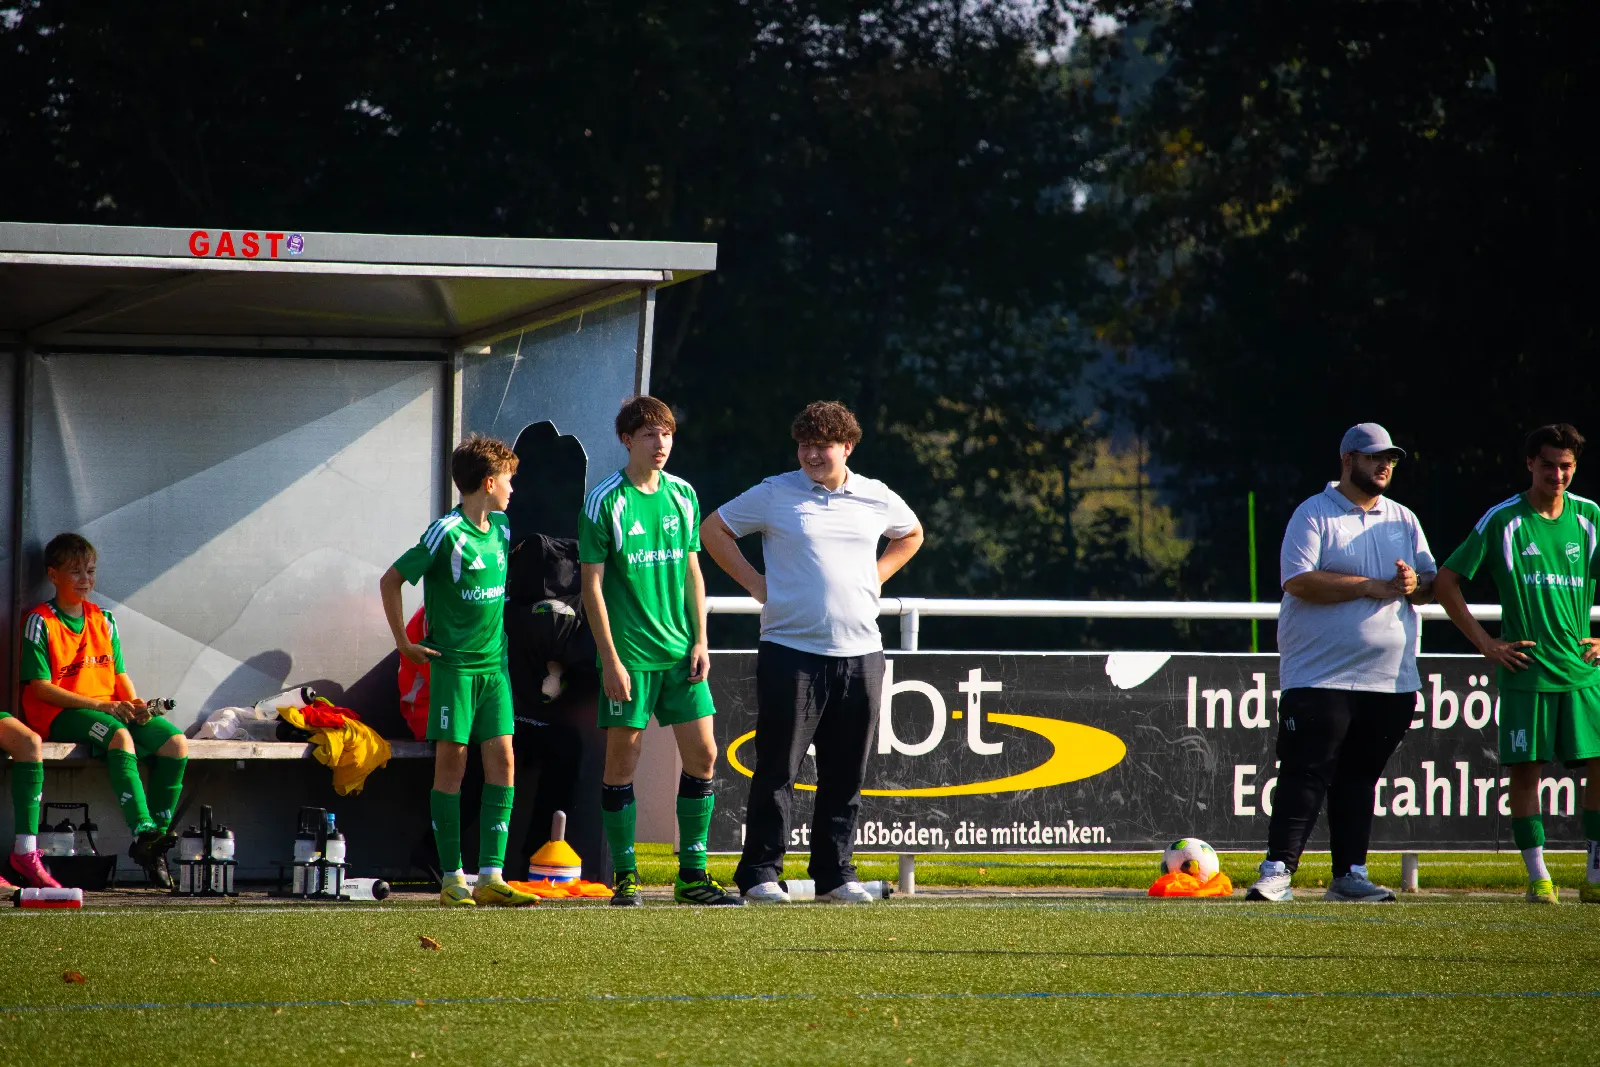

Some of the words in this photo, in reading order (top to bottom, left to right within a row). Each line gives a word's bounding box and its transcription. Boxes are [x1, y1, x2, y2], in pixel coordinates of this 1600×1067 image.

[188, 230, 285, 259] GAST
[627, 548, 685, 565] WÖHRMANN
[1523, 570, 1584, 588] WÖHRMANN
[461, 584, 506, 600] WÖHRMA
[440, 706, 450, 729] 6
[806, 659, 1003, 756] bt
[88, 721, 110, 742] 18
[1510, 729, 1528, 753] 14
[954, 821, 987, 845] die
[990, 820, 1112, 844] mitdenken.
